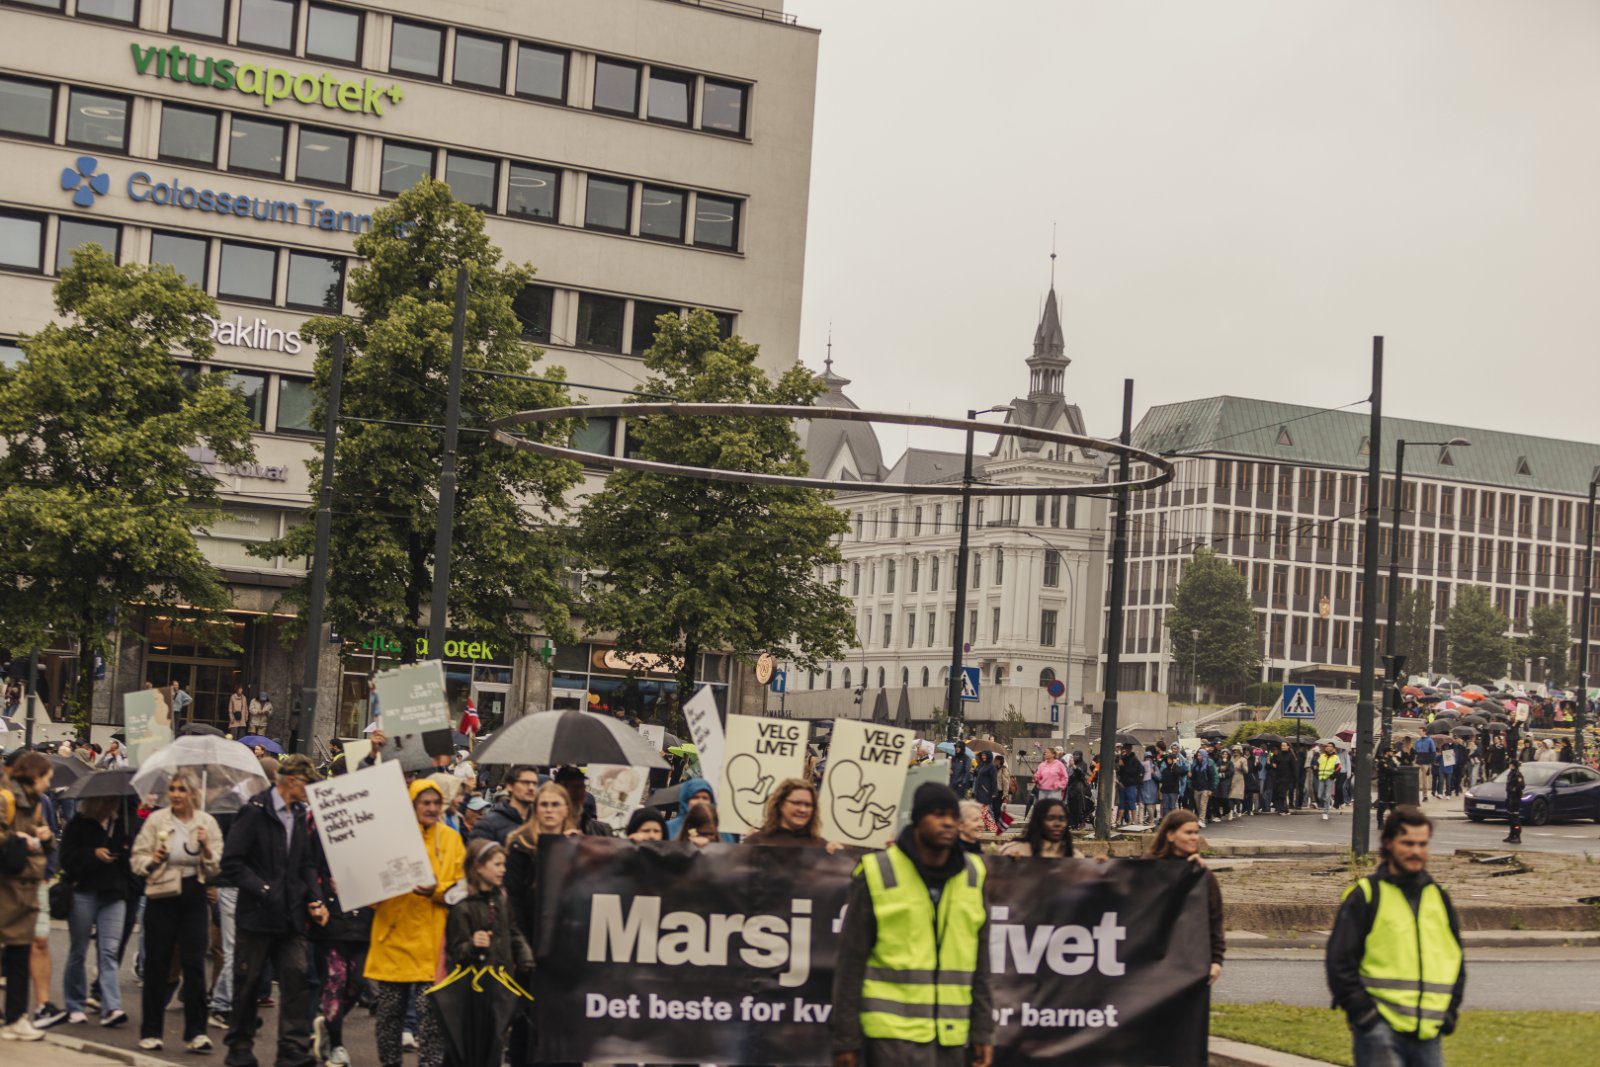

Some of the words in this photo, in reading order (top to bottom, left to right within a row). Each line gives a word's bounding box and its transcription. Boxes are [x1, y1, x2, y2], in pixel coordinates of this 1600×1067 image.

[127, 171, 298, 224] Colosseum
[304, 198, 375, 234] Tann
[758, 722, 800, 741] VELG
[864, 728, 906, 749] VELG
[756, 739, 799, 758] LIVET
[860, 745, 902, 766] LIVET
[314, 787, 334, 799] For
[319, 789, 370, 810] skrikene
[322, 808, 348, 822] som
[325, 815, 354, 833] aldri
[354, 810, 375, 824] ble
[586, 893, 812, 988] Marsj
[989, 905, 1126, 977] ivet
[585, 993, 640, 1020] Det
[648, 993, 733, 1021] beste
[740, 996, 786, 1023] for
[1021, 1002, 1119, 1028] barnet
